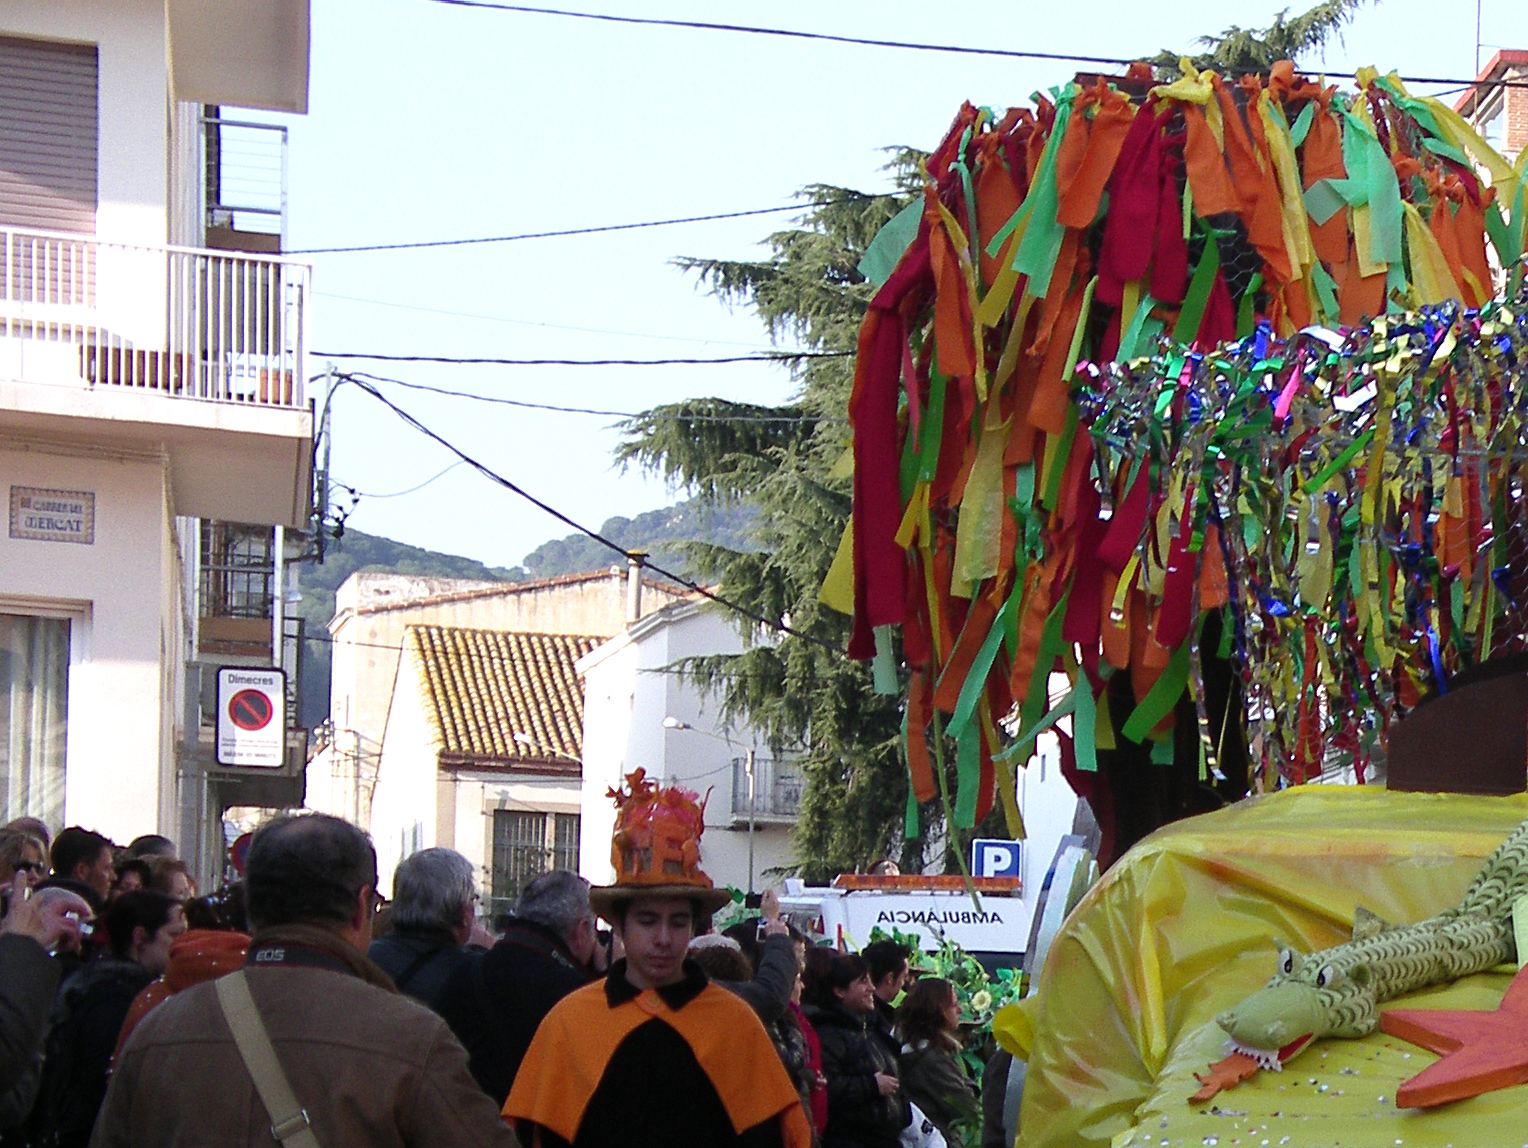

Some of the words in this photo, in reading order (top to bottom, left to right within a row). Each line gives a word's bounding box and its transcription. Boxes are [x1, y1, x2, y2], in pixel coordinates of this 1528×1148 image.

[25, 516, 83, 532] MERCAT
[228, 674, 273, 686] Dimecres
[983, 846, 1012, 878] P
[256, 949, 285, 961] EOS
